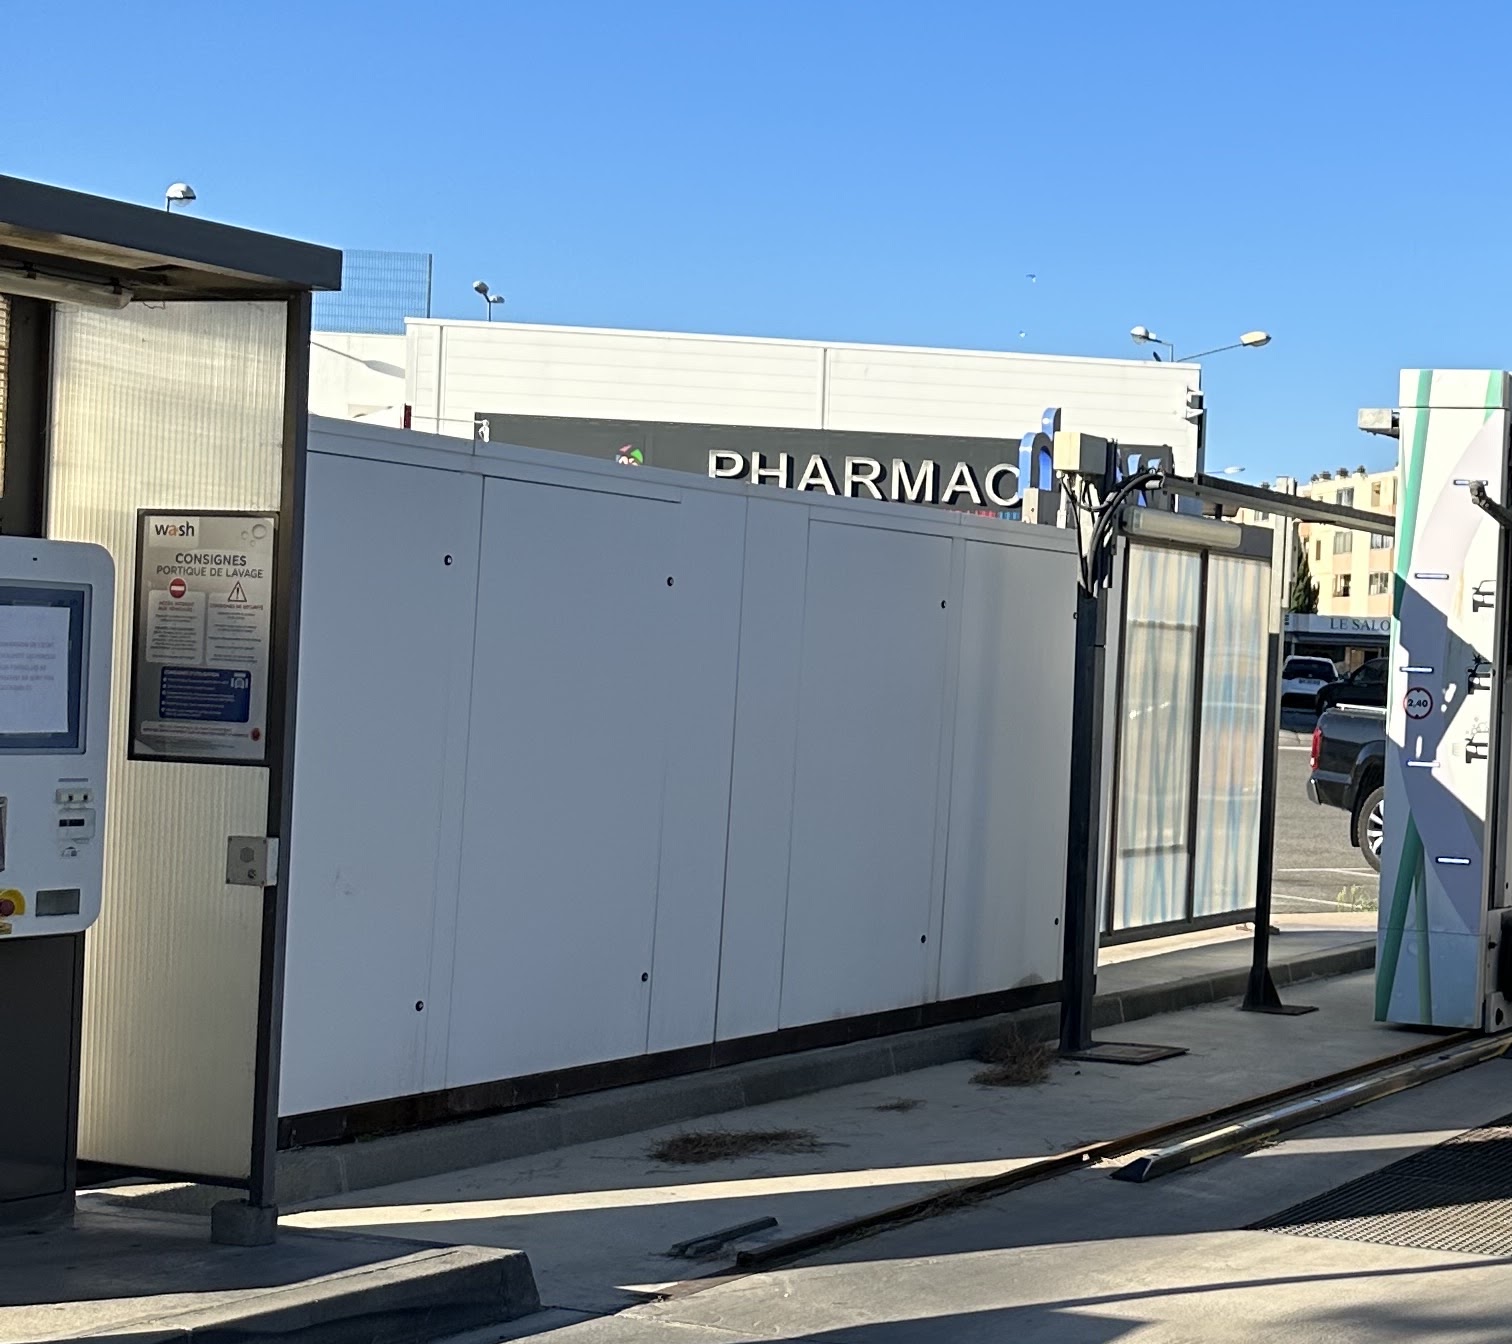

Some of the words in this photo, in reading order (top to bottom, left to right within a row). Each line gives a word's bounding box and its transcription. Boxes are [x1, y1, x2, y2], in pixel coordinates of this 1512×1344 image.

[155, 520, 195, 537] wash
[175, 552, 247, 567] CONSIGNES
[156, 565, 206, 577] PORTIQUE
[210, 567, 223, 577] DE
[226, 567, 264, 579] LAVAGE
[1330, 617, 1348, 630] LE
